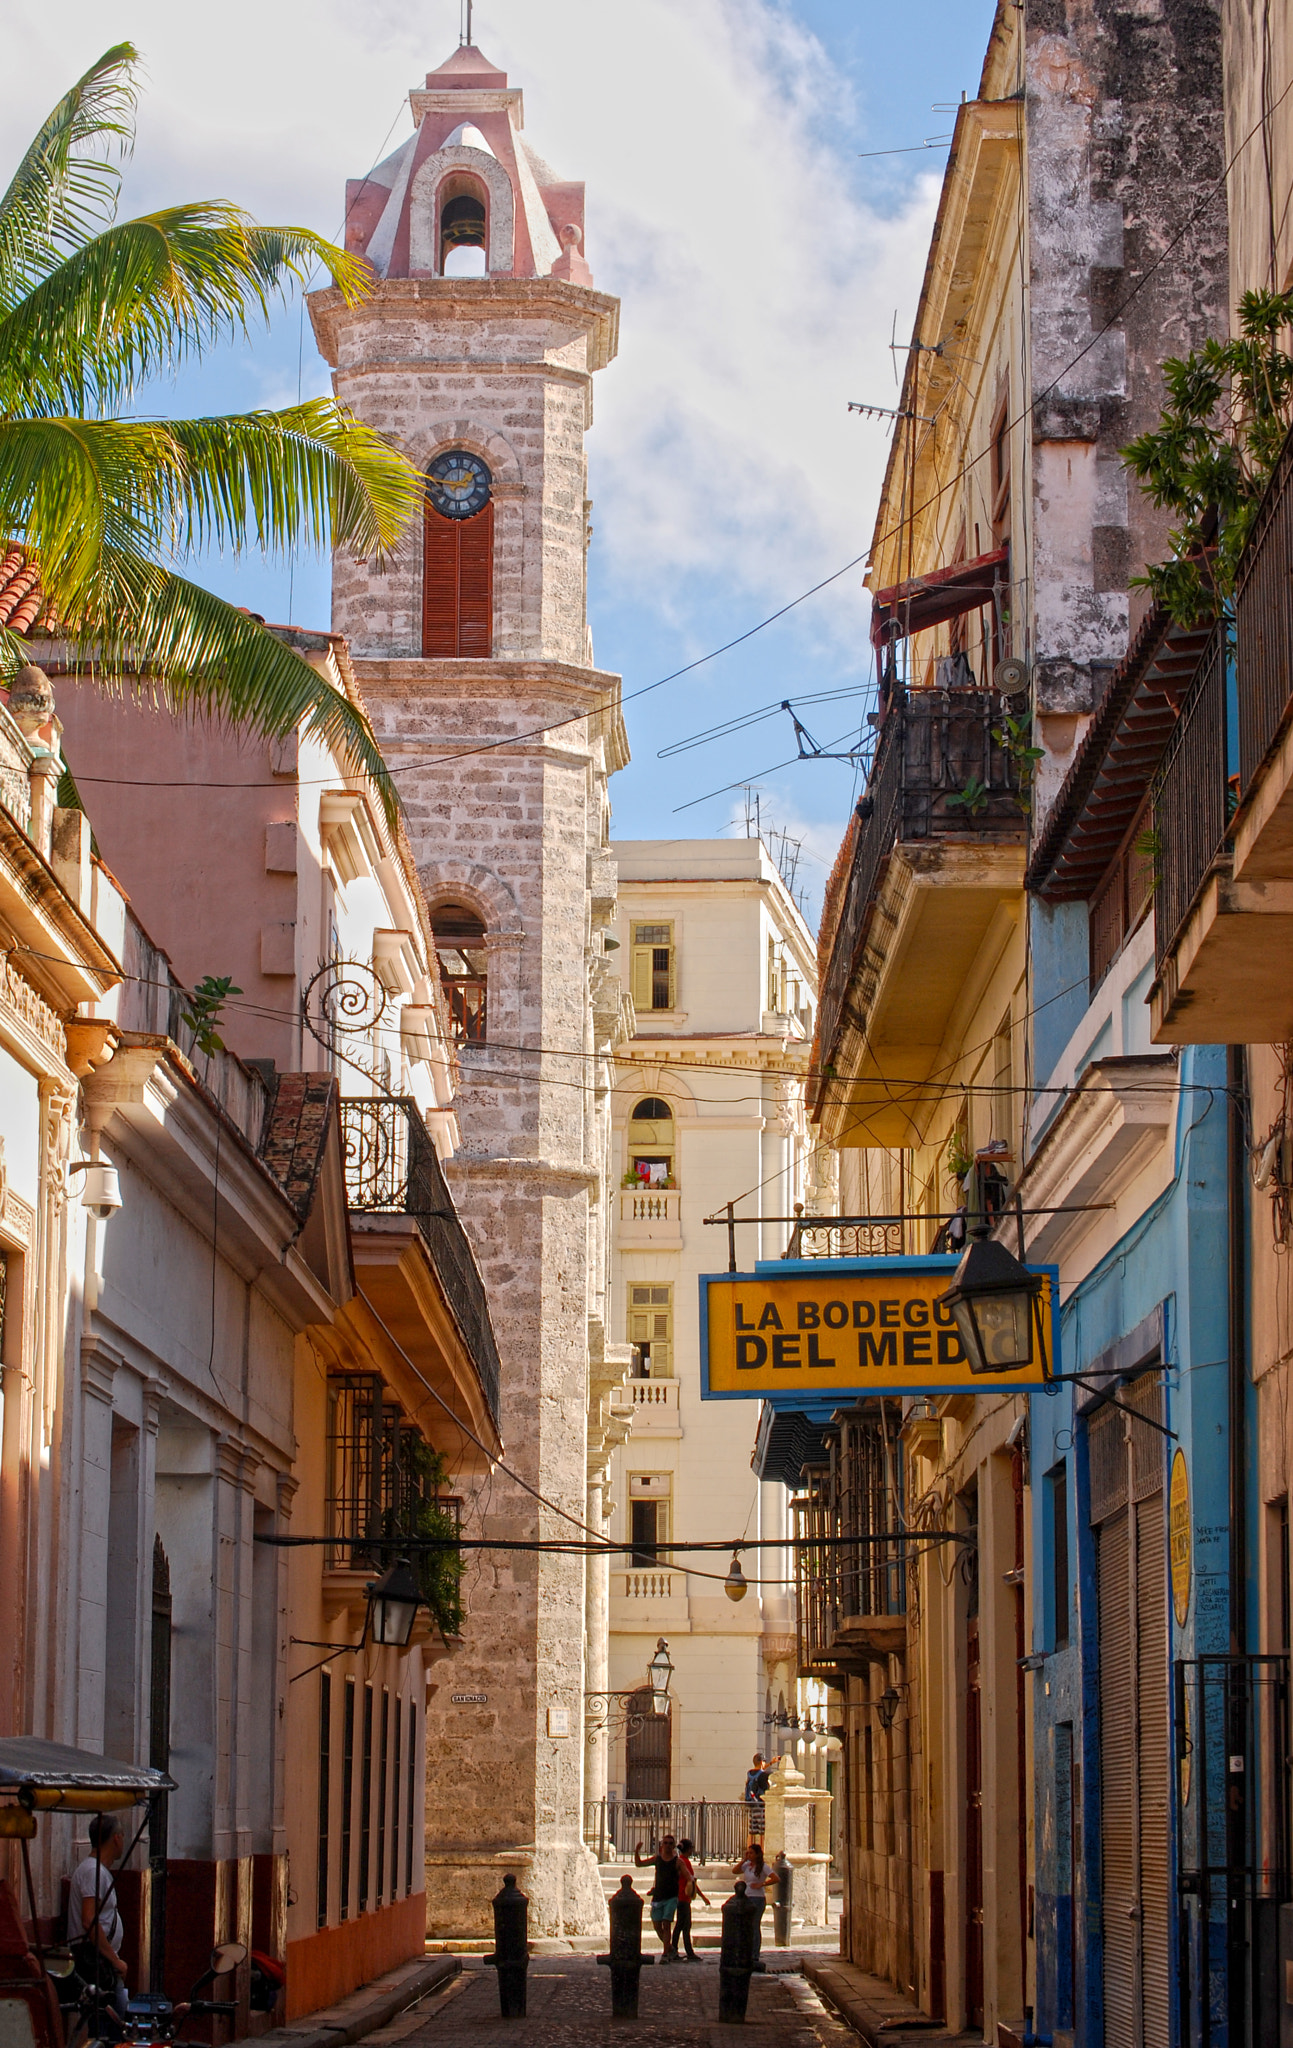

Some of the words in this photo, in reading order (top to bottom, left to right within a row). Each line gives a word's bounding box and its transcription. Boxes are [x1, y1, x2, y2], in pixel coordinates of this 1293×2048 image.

[735, 1302, 784, 1330] LA
[797, 1299, 1025, 1329] BODEGU
[736, 1332, 836, 1370] DEL
